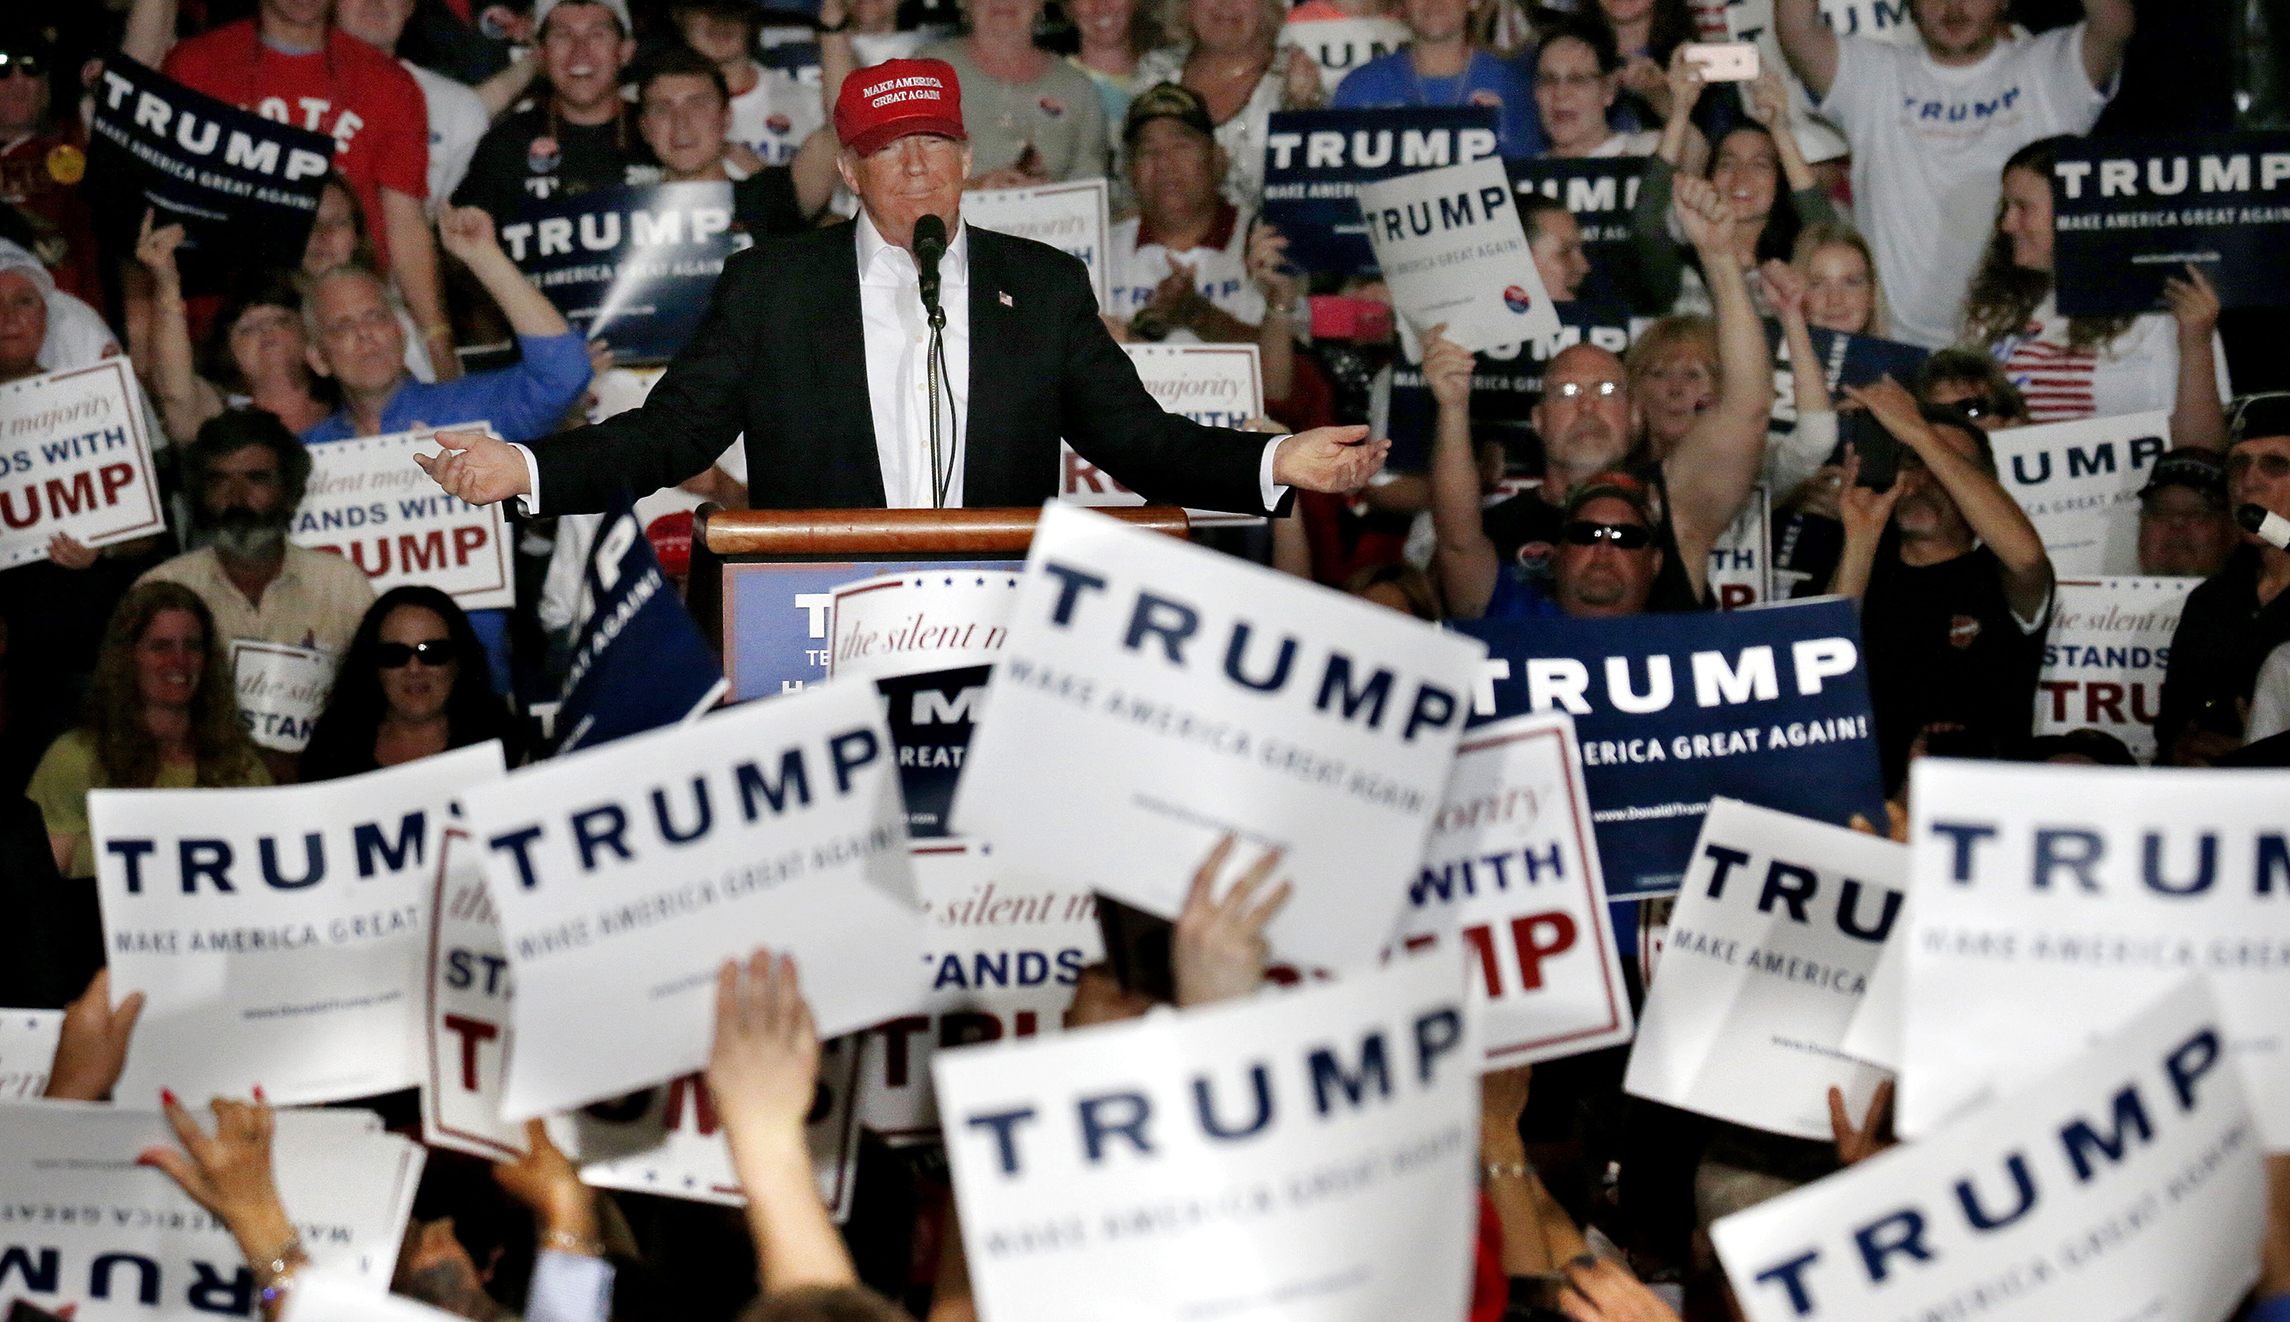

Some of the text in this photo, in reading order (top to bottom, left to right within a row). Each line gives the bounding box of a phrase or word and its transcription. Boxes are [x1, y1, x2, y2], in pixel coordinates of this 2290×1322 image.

[862, 76, 944, 99] MAKE AMERICA
[871, 89, 941, 109] GREAT AGAIN
[104, 70, 329, 181] TRUMP
[1268, 127, 1498, 170] TRUMP
[130, 140, 196, 183] AMERICA
[199, 171, 251, 197] GREAT
[2055, 152, 2290, 199] TRUMP
[502, 208, 732, 262] TRUMP
[1366, 185, 1507, 246] TRUMP
[2104, 210, 2179, 229] AMERICA
[2181, 206, 2236, 226] GREAT
[41, 424, 127, 464] WITH
[2012, 435, 2166, 485] UMP
[0, 462, 136, 530] UMP
[290, 502, 391, 534] ANDS
[312, 525, 488, 580] UMP
[839, 620, 879, 662] the
[882, 612, 977, 654] silent
[1042, 561, 1459, 742] TRUMP
[1472, 636, 1858, 717] TRUMP
[2040, 681, 2163, 724] TRU
[900, 744, 965, 769] REAT
[1577, 714, 1870, 766] ERICA GREAT AGAIN!
[489, 727, 880, 891] TRUMP
[106, 808, 440, 894] TRUM
[1409, 841, 1566, 907] WITH
[938, 879, 1055, 926] silent
[1704, 843, 1905, 943] TRU
[188, 923, 320, 954] AMERICA
[327, 905, 421, 945] GREAT
[926, 948, 1081, 990] ANDS
[1672, 926, 1868, 996] MAKE AMERICA
[967, 1007, 1462, 1176] TRUMP
[1755, 1026, 2222, 1316] TRUMP
[0, 1246, 254, 1317] RUM
